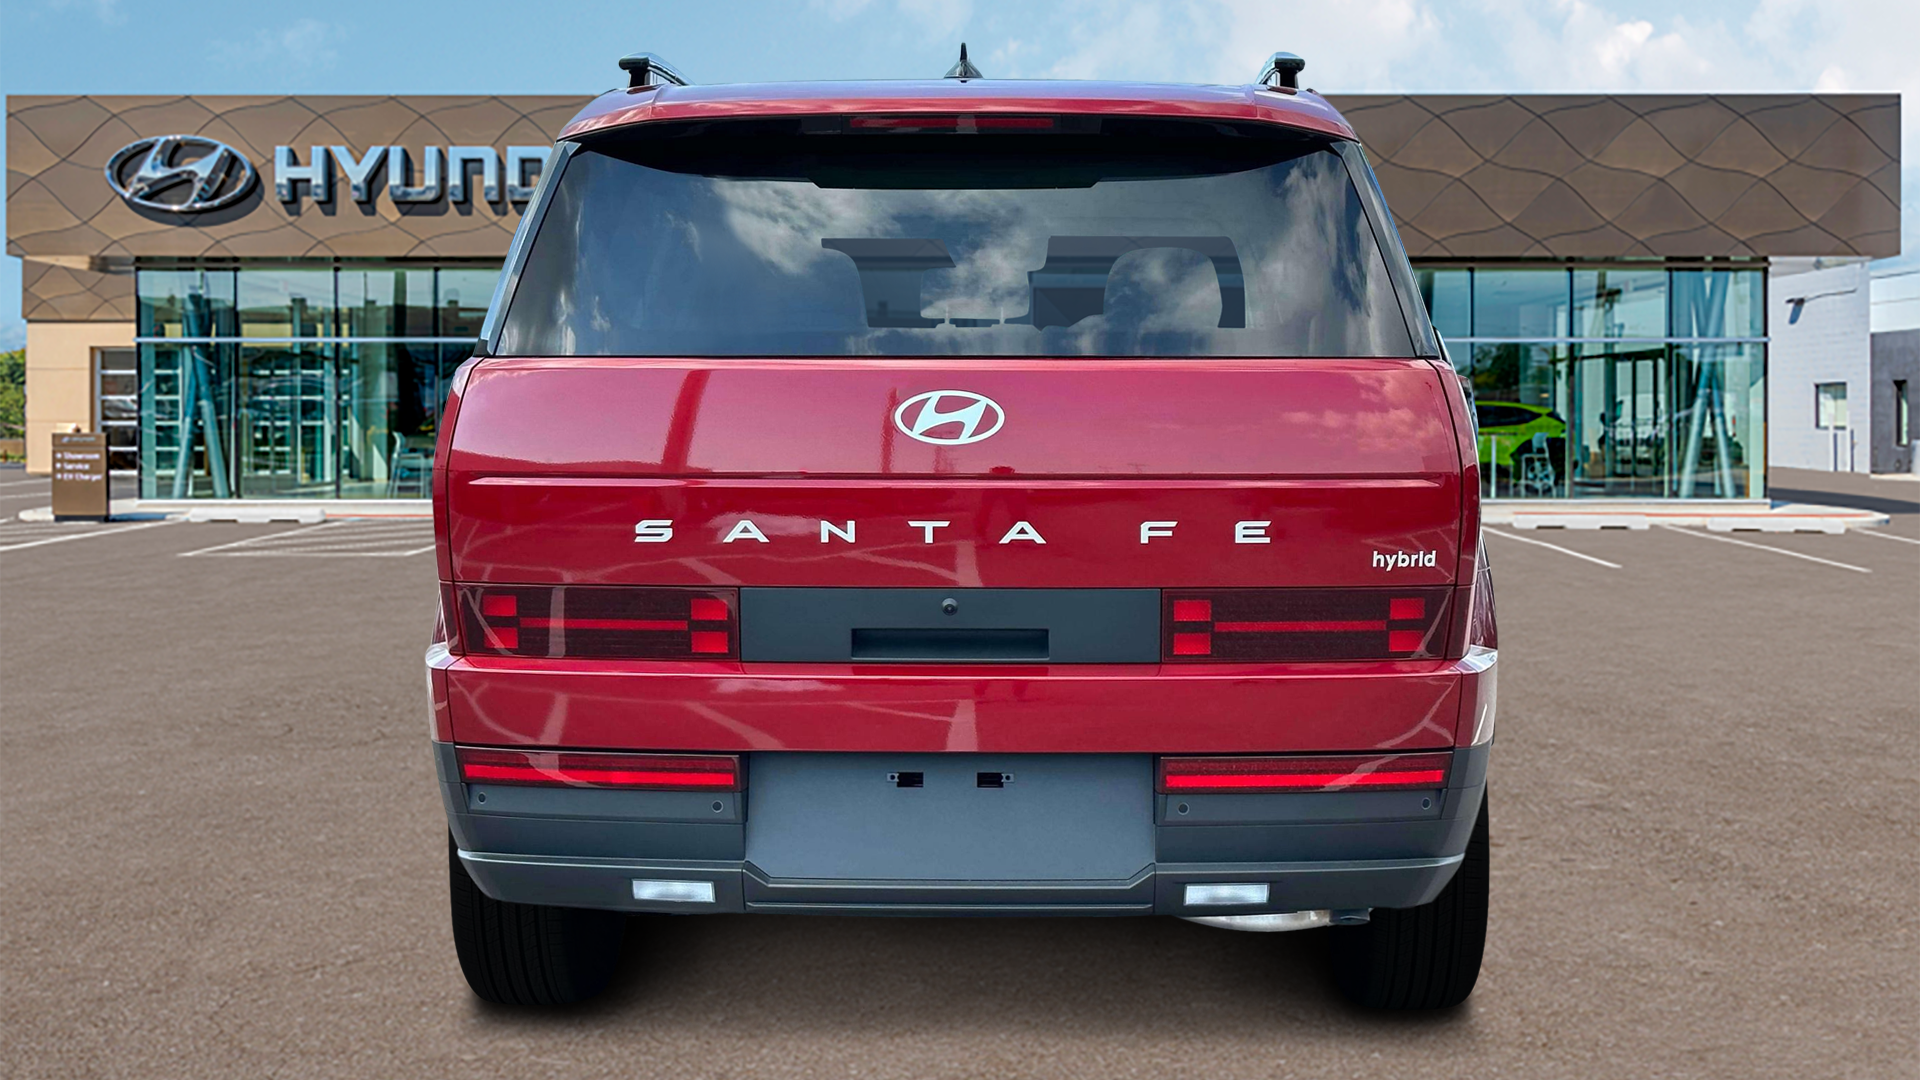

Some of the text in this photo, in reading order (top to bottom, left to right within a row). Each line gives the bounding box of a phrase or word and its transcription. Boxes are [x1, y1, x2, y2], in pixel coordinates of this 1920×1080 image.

[634, 519, 1272, 545] SANTA FE
[1372, 550, 1437, 572] hybrid
